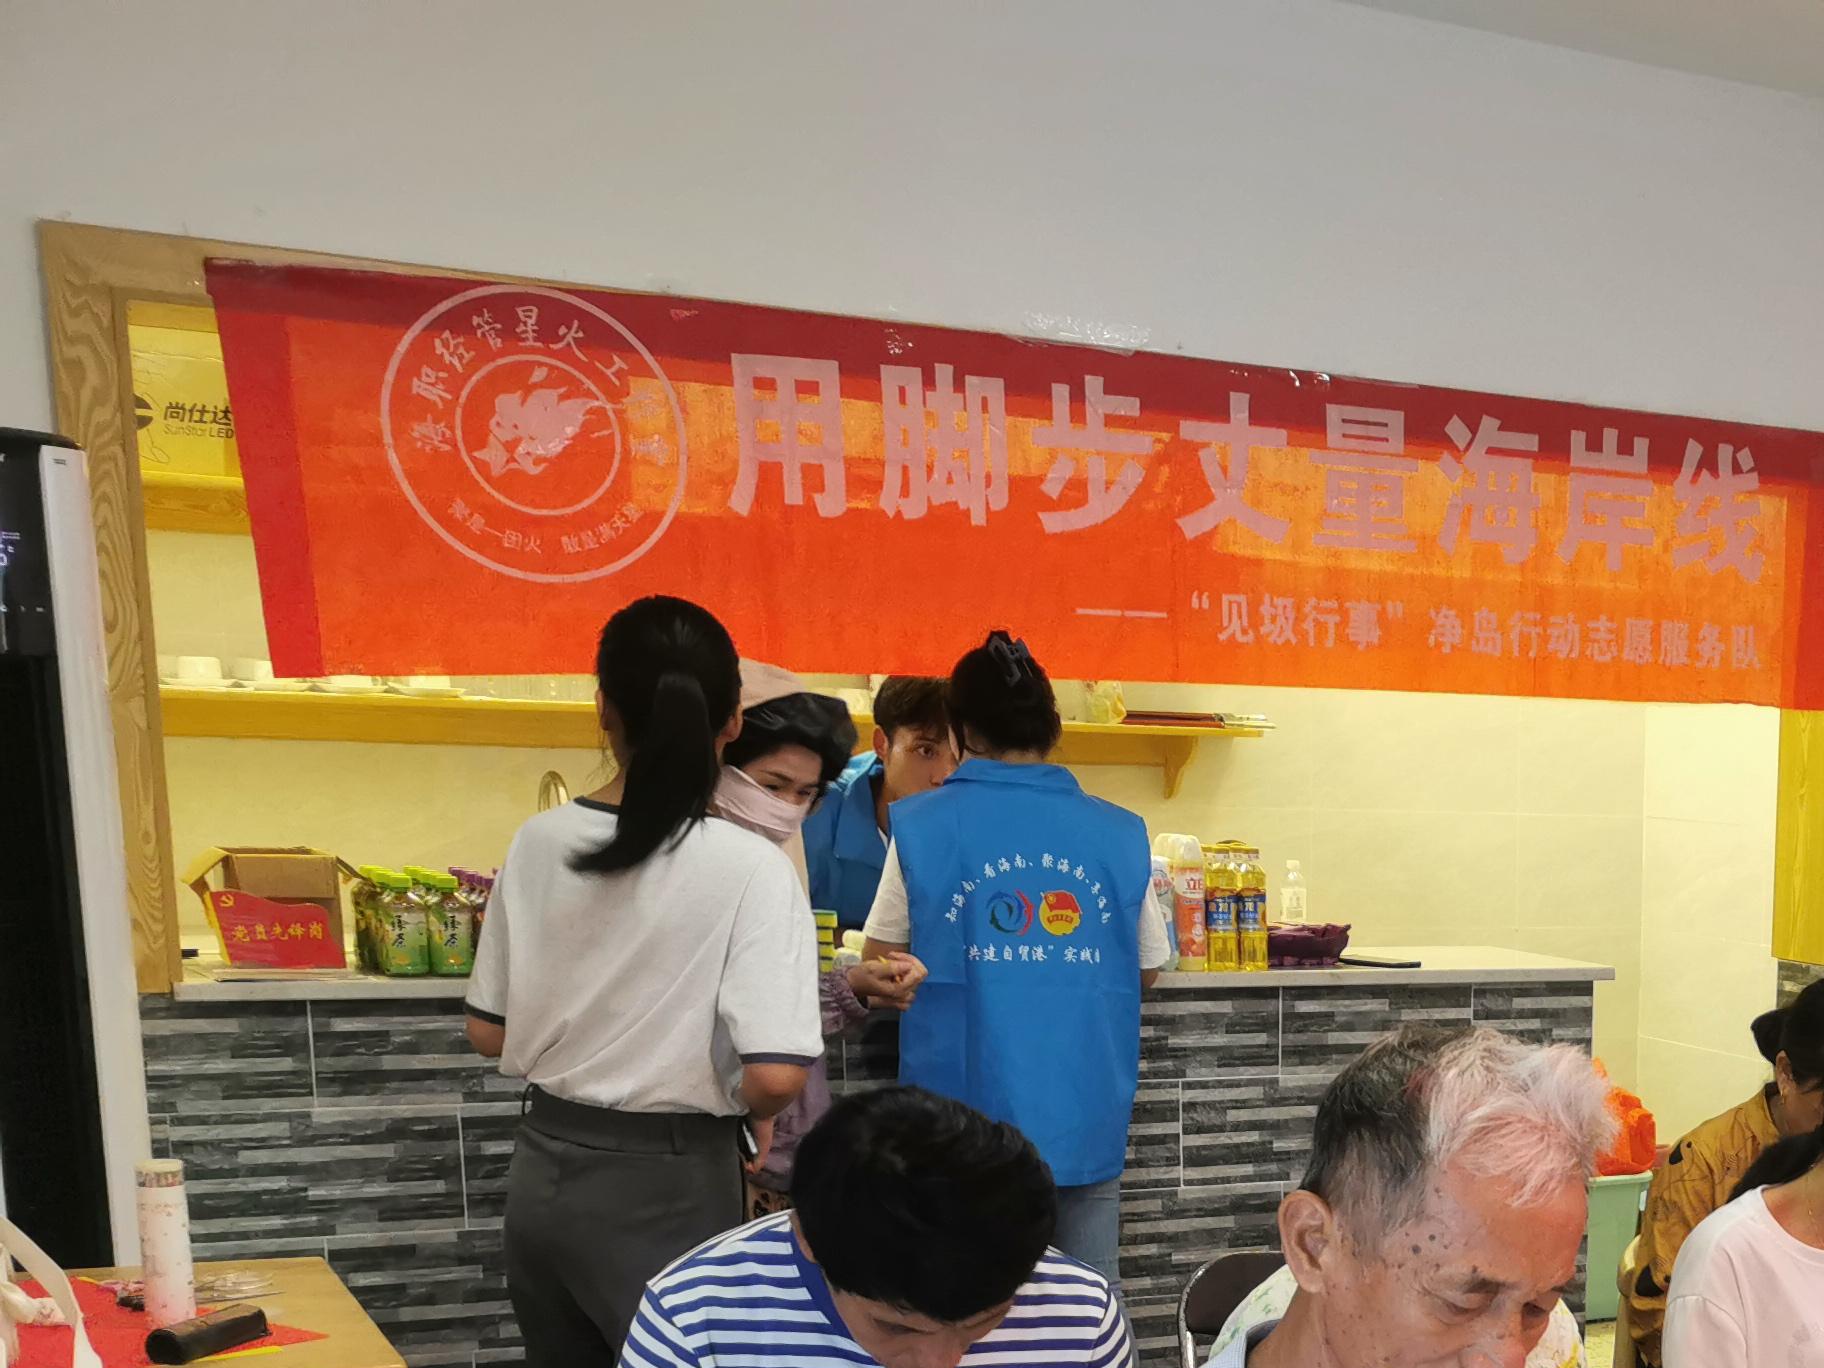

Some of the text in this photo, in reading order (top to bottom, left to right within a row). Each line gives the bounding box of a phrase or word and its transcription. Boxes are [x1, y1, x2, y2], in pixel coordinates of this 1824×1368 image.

[163, 402, 232, 426] 尚仕达
[209, 428, 234, 439] LED
[728, 353, 1764, 584] 用脚步丈量海岸线
